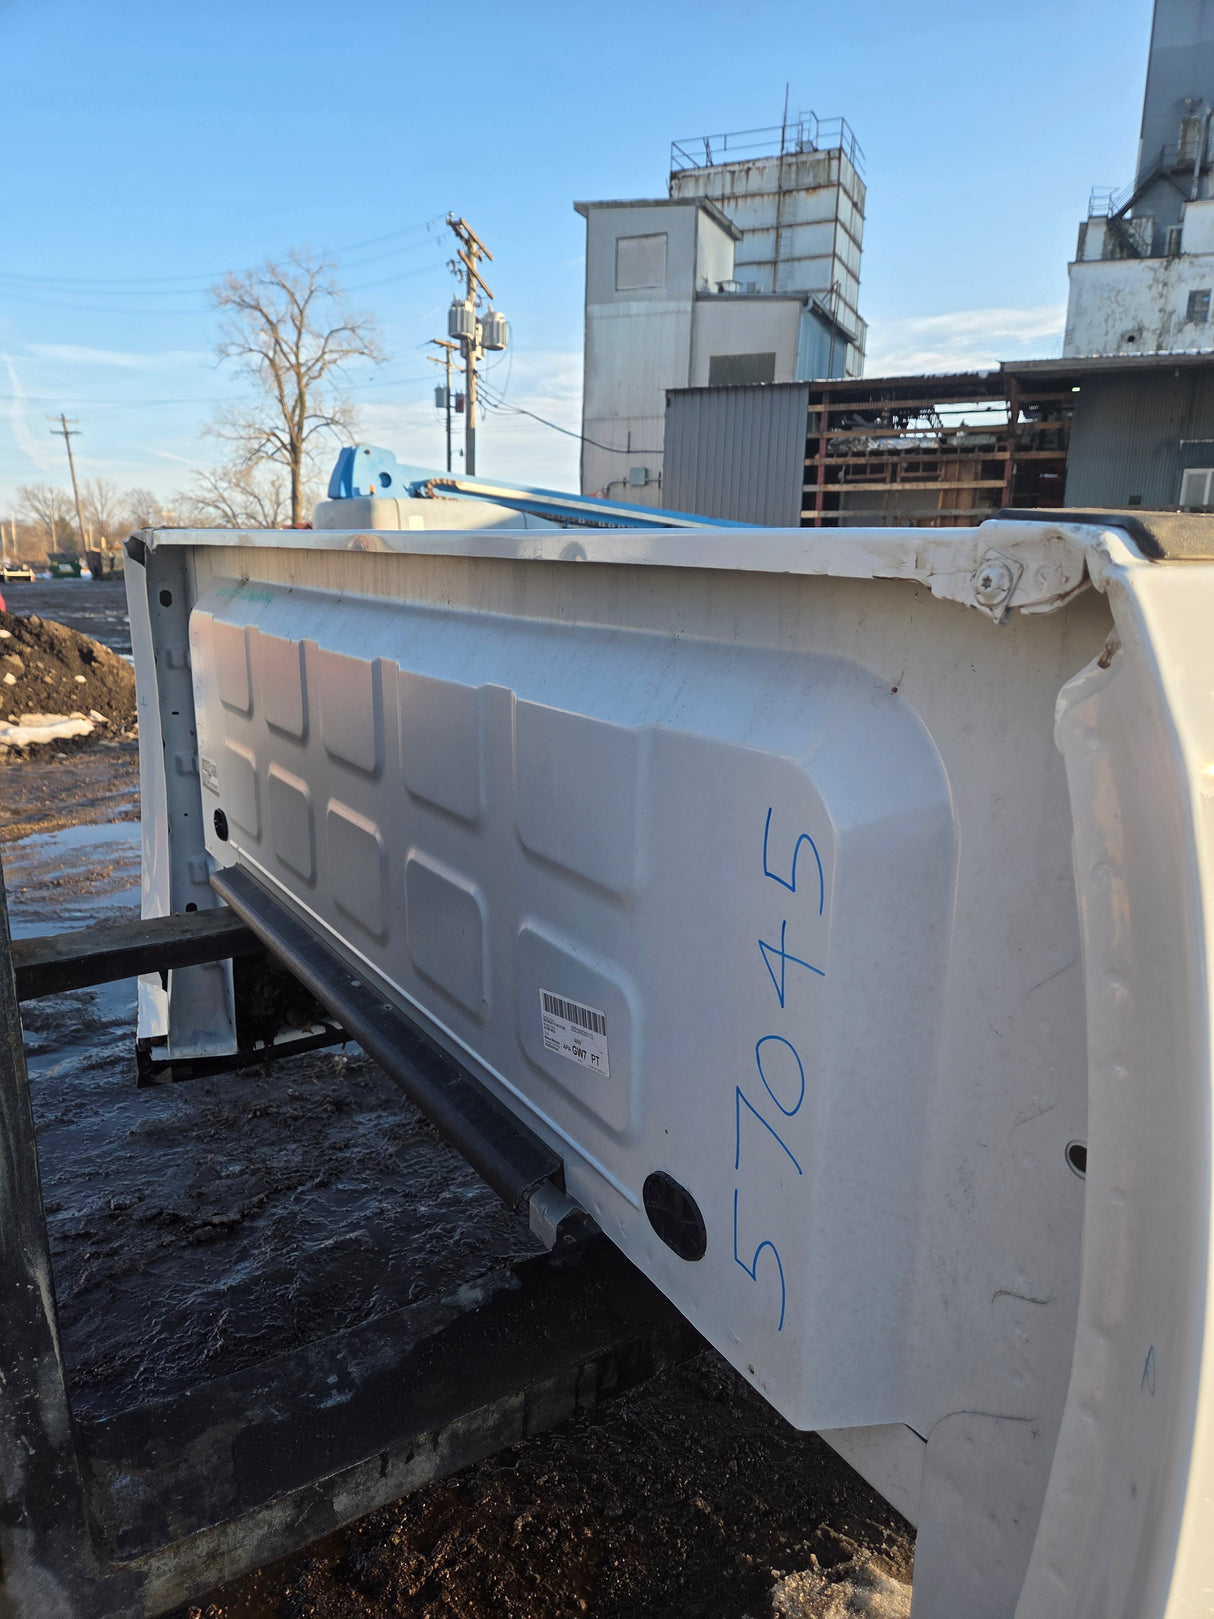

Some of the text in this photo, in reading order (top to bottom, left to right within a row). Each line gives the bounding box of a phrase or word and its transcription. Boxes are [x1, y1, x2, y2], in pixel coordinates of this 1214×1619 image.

[571, 1045, 587, 1060] GW7
[590, 1053, 600, 1066] PT
[734, 806, 826, 1331] 57045
